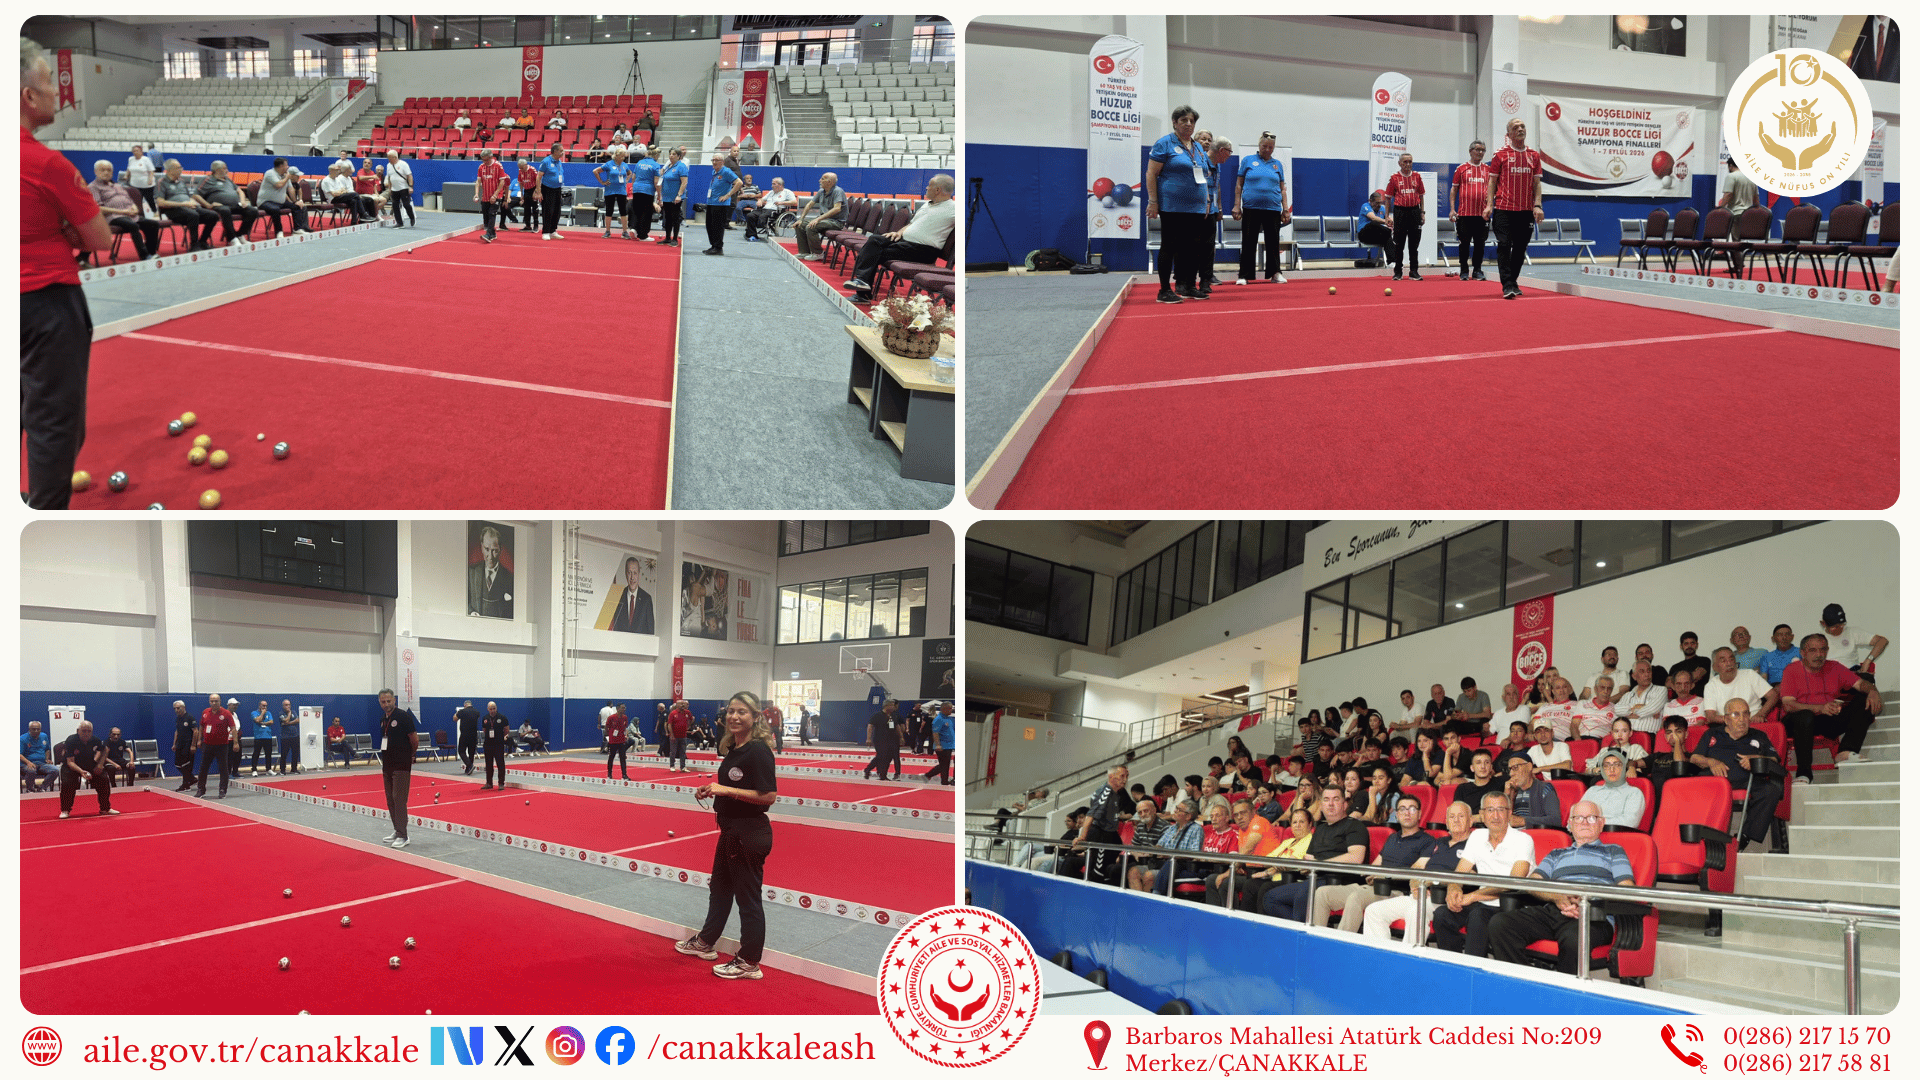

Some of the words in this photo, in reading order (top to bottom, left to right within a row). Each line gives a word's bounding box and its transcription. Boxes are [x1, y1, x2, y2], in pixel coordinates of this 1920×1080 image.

[1100, 97, 1132, 109] HUZUR
[1091, 110, 1120, 121] BOCCE
[1123, 111, 1141, 123] LİGİ
[1589, 107, 1652, 120] HOŞGELDİNİZ
[1378, 123, 1402, 132] HUZUR
[1577, 127, 1610, 137] HUZUR
[1613, 129, 1641, 138] BOCCE
[1644, 128, 1662, 139] LİGİ
[1372, 134, 1393, 143] BOCCE
[1577, 138, 1623, 147] ŞAMPİYONA
[1625, 139, 1661, 148] FİNALLERİ
[1324, 547, 1341, 568] Ben
[1519, 652, 1544, 669] BOCCE
